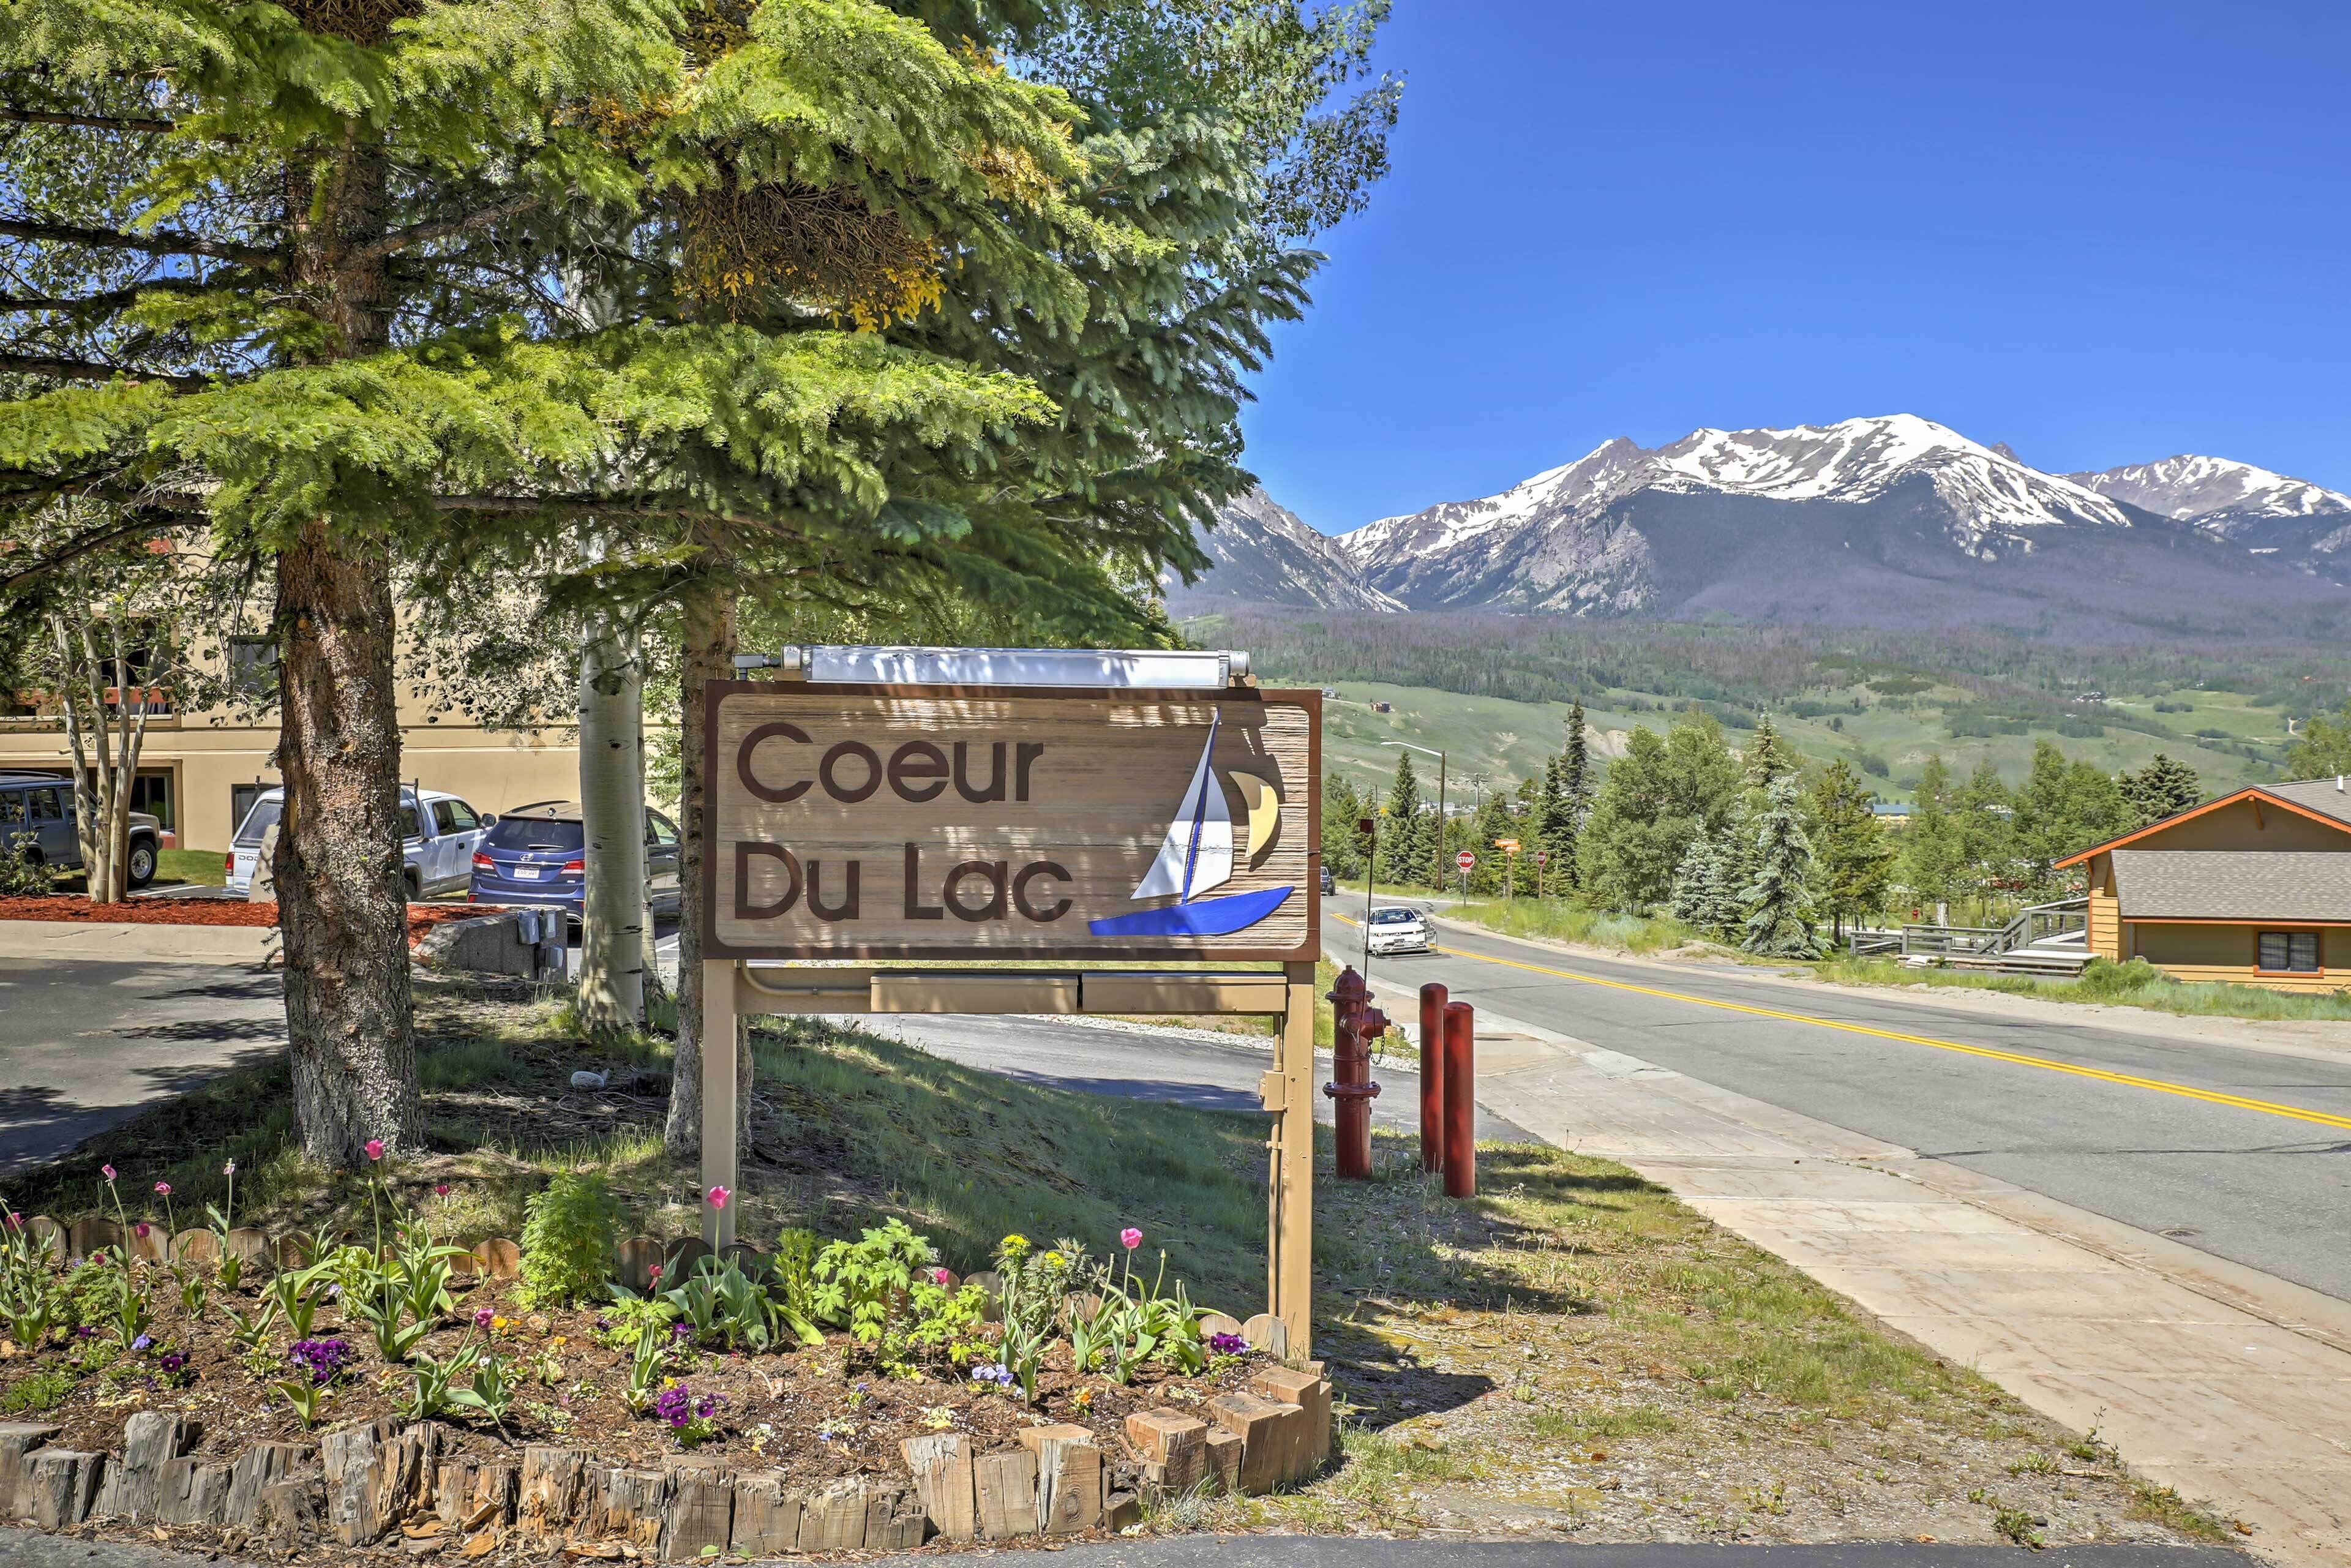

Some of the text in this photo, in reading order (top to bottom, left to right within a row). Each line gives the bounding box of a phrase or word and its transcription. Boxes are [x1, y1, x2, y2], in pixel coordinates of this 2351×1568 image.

[737, 723, 1044, 803] Coeur
[735, 842, 1073, 922] Du Lac
